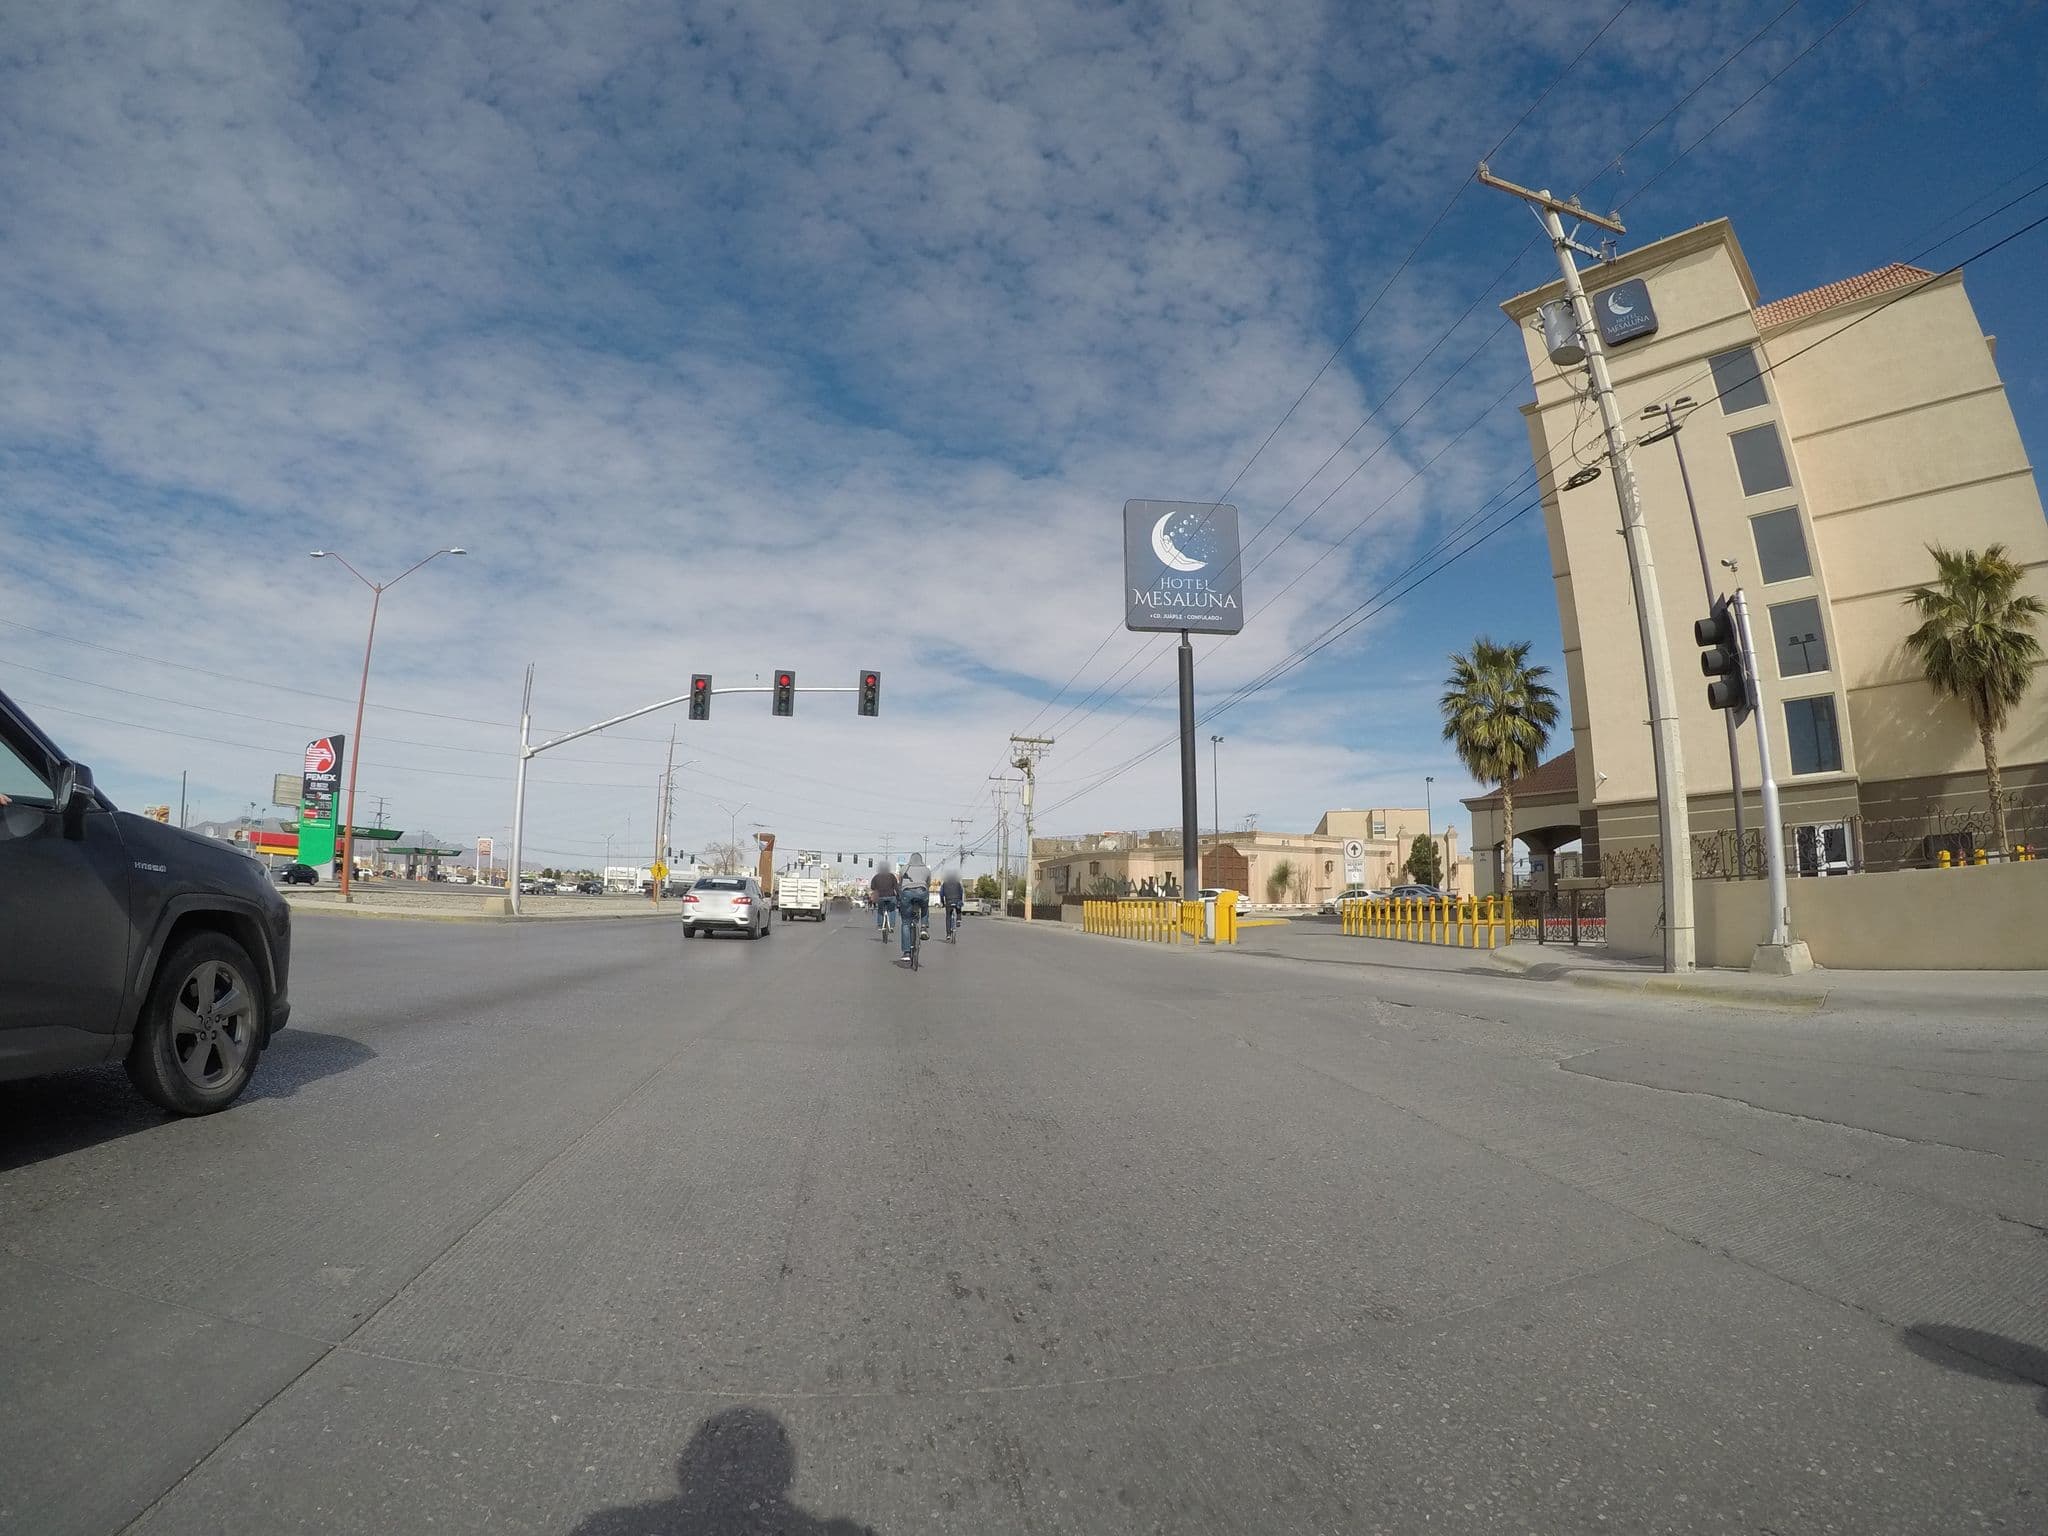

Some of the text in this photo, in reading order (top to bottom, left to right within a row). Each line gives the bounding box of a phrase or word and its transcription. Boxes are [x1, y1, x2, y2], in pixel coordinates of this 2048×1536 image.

[1607, 315, 1650, 333] MESALUNA
[1160, 576, 1216, 593] HOTEL
[1133, 589, 1237, 608] MESALUNA
[305, 773, 336, 781] PEMEX
